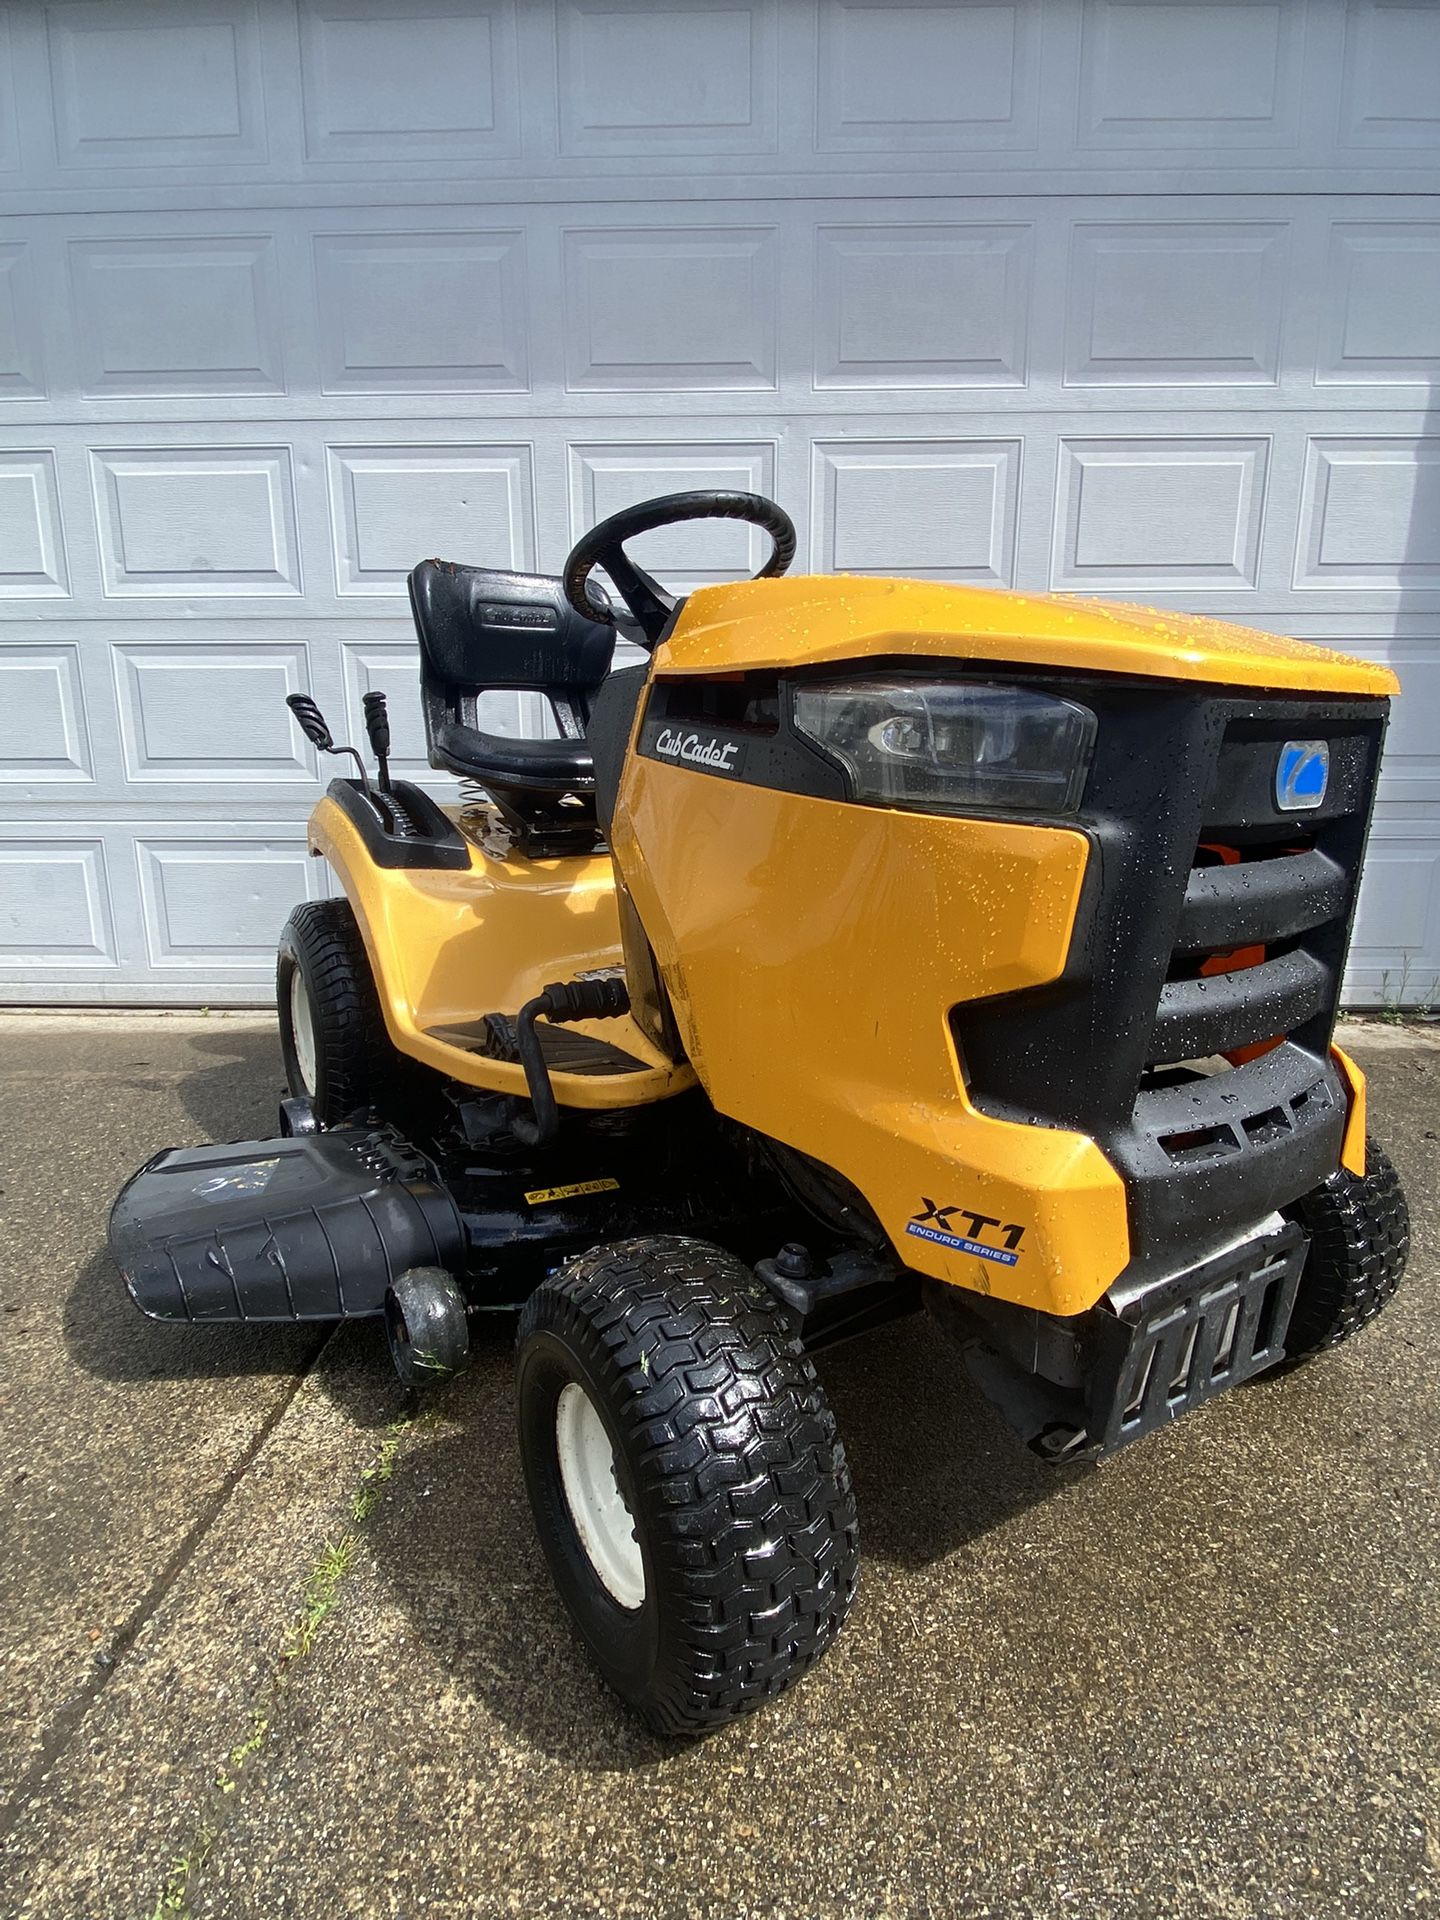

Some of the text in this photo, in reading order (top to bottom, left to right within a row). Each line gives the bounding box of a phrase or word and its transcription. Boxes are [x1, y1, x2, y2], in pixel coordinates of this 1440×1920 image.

[656, 729, 739, 770] Cub Cadet
[908, 1224, 1012, 1262] ENDURO SERIES
[910, 1196, 1026, 1250] XT1
